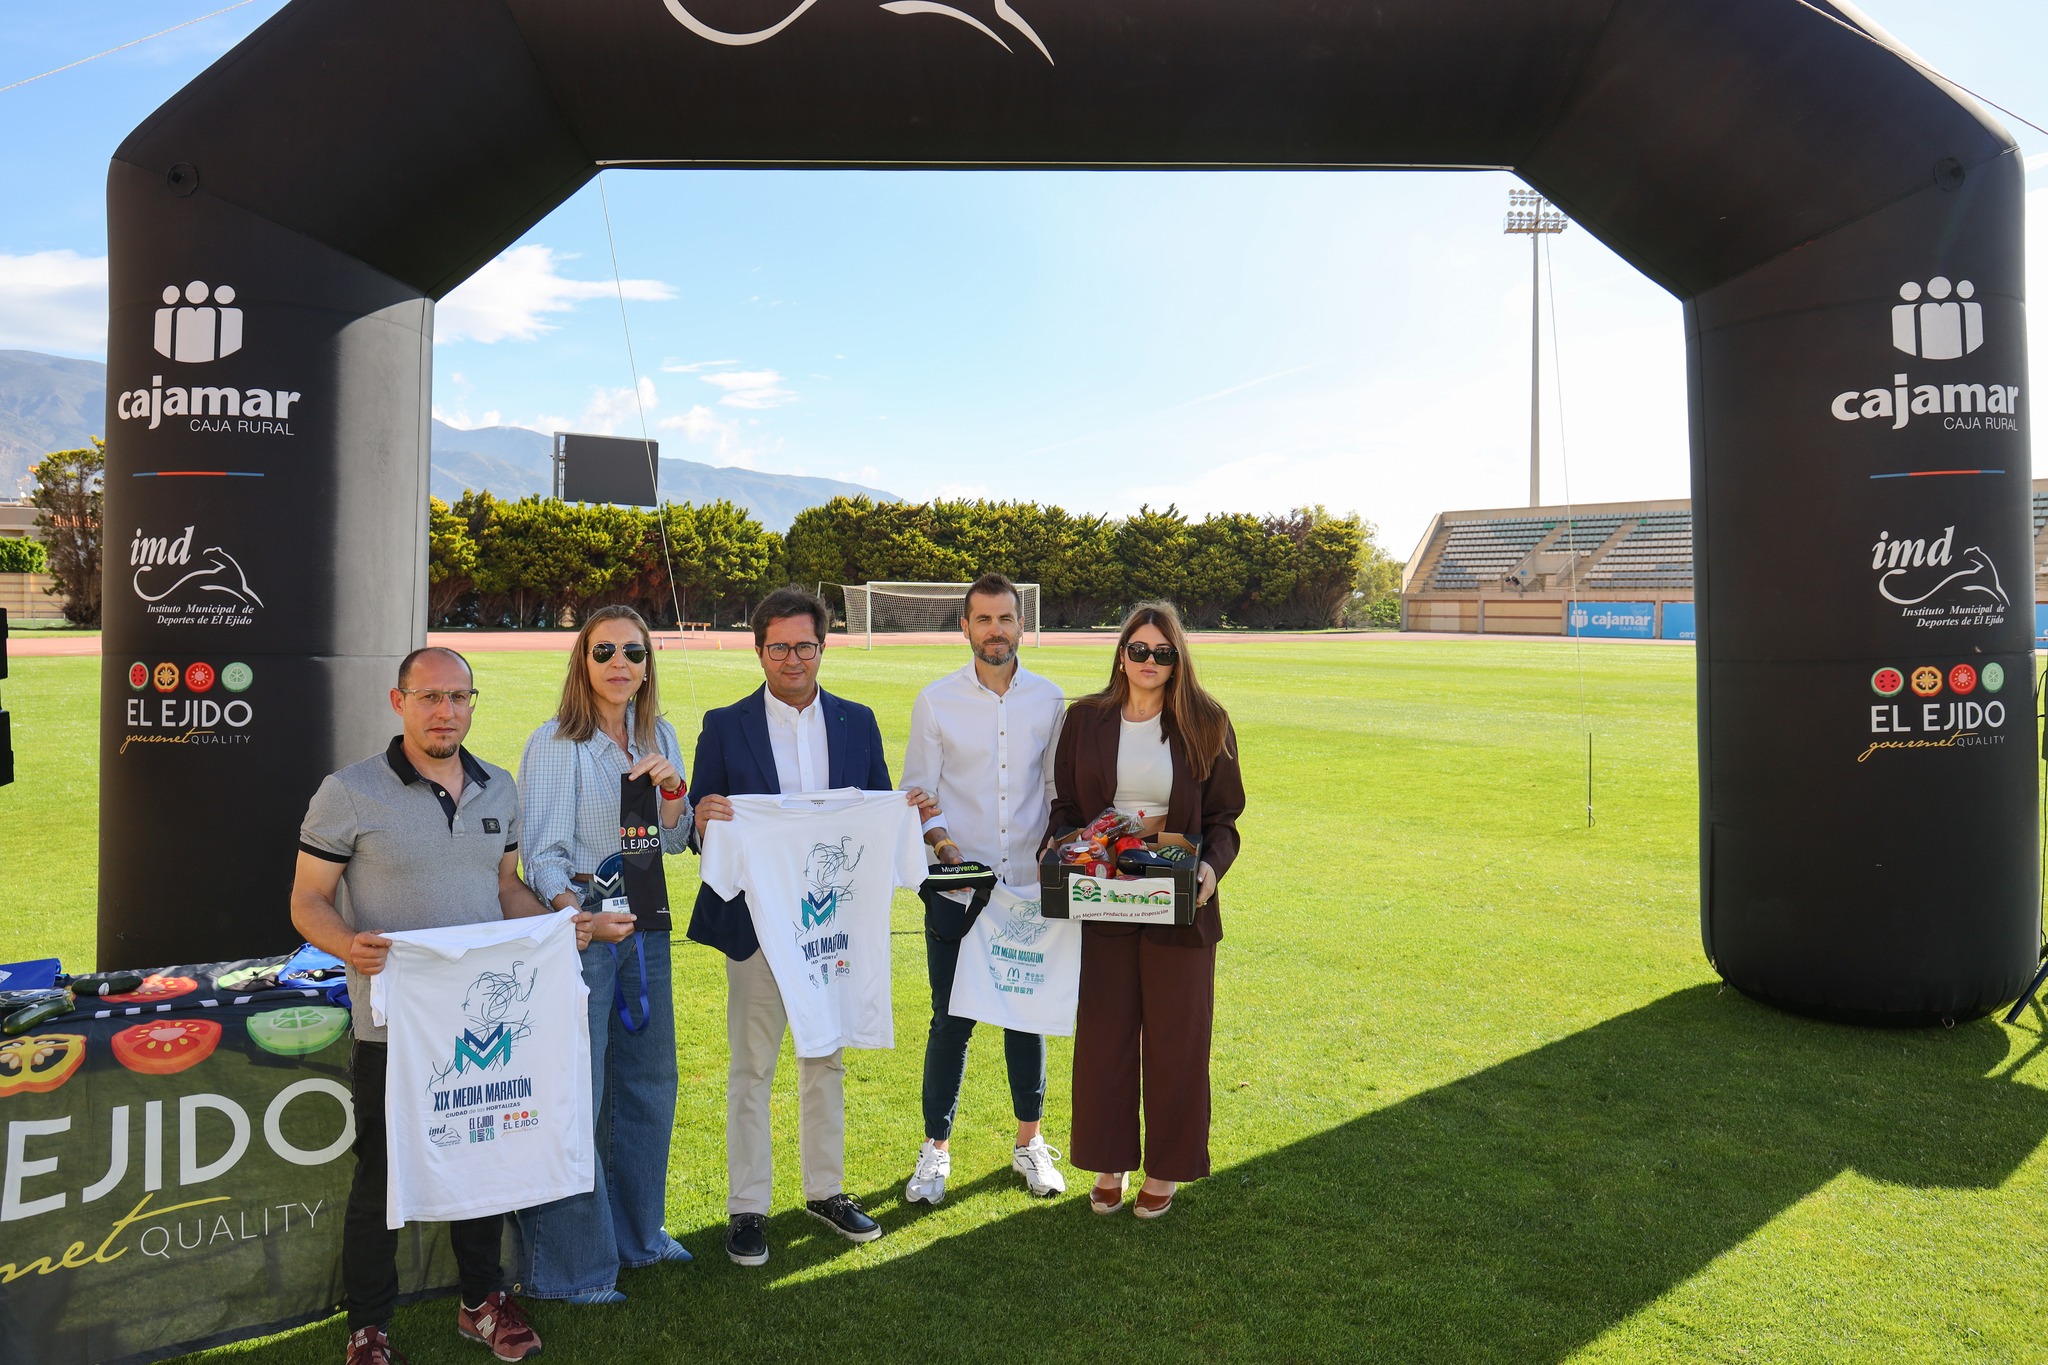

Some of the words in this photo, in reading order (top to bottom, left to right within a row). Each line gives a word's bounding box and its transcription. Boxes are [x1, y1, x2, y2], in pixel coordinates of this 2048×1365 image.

[117, 374, 302, 430] cajamar
[1830, 373, 2019, 430] cajamar
[189, 419, 232, 432] CAJA
[238, 420, 295, 436] RURAL
[1943, 416, 1981, 430] CAJA
[1986, 417, 2018, 432] RURAL
[130, 525, 195, 566] imd
[1871, 525, 1955, 570] imd
[146, 604, 181, 613] Instituto
[185, 603, 236, 615] Municipal
[241, 604, 255, 614] de
[1901, 607, 1944, 617] Instituto
[1949, 604, 1993, 616] Municipal
[1996, 603, 2005, 613] de
[156, 615, 195, 626] Deportes
[197, 615, 209, 624] de
[210, 615, 222, 624] El
[224, 615, 253, 626] Ejido
[1591, 611, 1651, 629] cajamar
[1916, 617, 1959, 629] Deportes
[1961, 616, 1972, 625] de
[1973, 615, 1983, 625] El
[1984, 614, 2004, 626] Ejido
[127, 698, 152, 727] EL
[161, 699, 253, 727] EJIDO
[1871, 704, 1911, 733] EL
[1923, 700, 2006, 732] EJIDO
[119, 727, 215, 755] gourmet
[191, 735, 251, 745] QUALITY
[1857, 729, 1979, 763] gourmet
[1956, 735, 2005, 748] QUALITY
[630, 838, 660, 849] EJIDO
[941, 864, 979, 873] Murgiverde
[1001, 946, 1017, 960] MEDIA
[1018, 950, 1044, 963] MARATÓN
[433, 1090, 450, 1112] XIX
[452, 1085, 483, 1109] MEDIA
[485, 1075, 532, 1103] MARATÓN
[445, 1110, 468, 1118] CIUDAD
[486, 1102, 521, 1111] HORTALIZAS
[428, 1124, 446, 1137] imd
[469, 1118, 476, 1130] EL
[476, 1115, 494, 1128] EJIDO
[503, 1122, 514, 1130] EL
[514, 1118, 539, 1128] EJIDO
[469, 1130, 477, 1143] 10
[485, 1127, 495, 1141] 26
[0, 1077, 357, 1223] EJIDO
[140, 1199, 323, 1259] QUALITY
